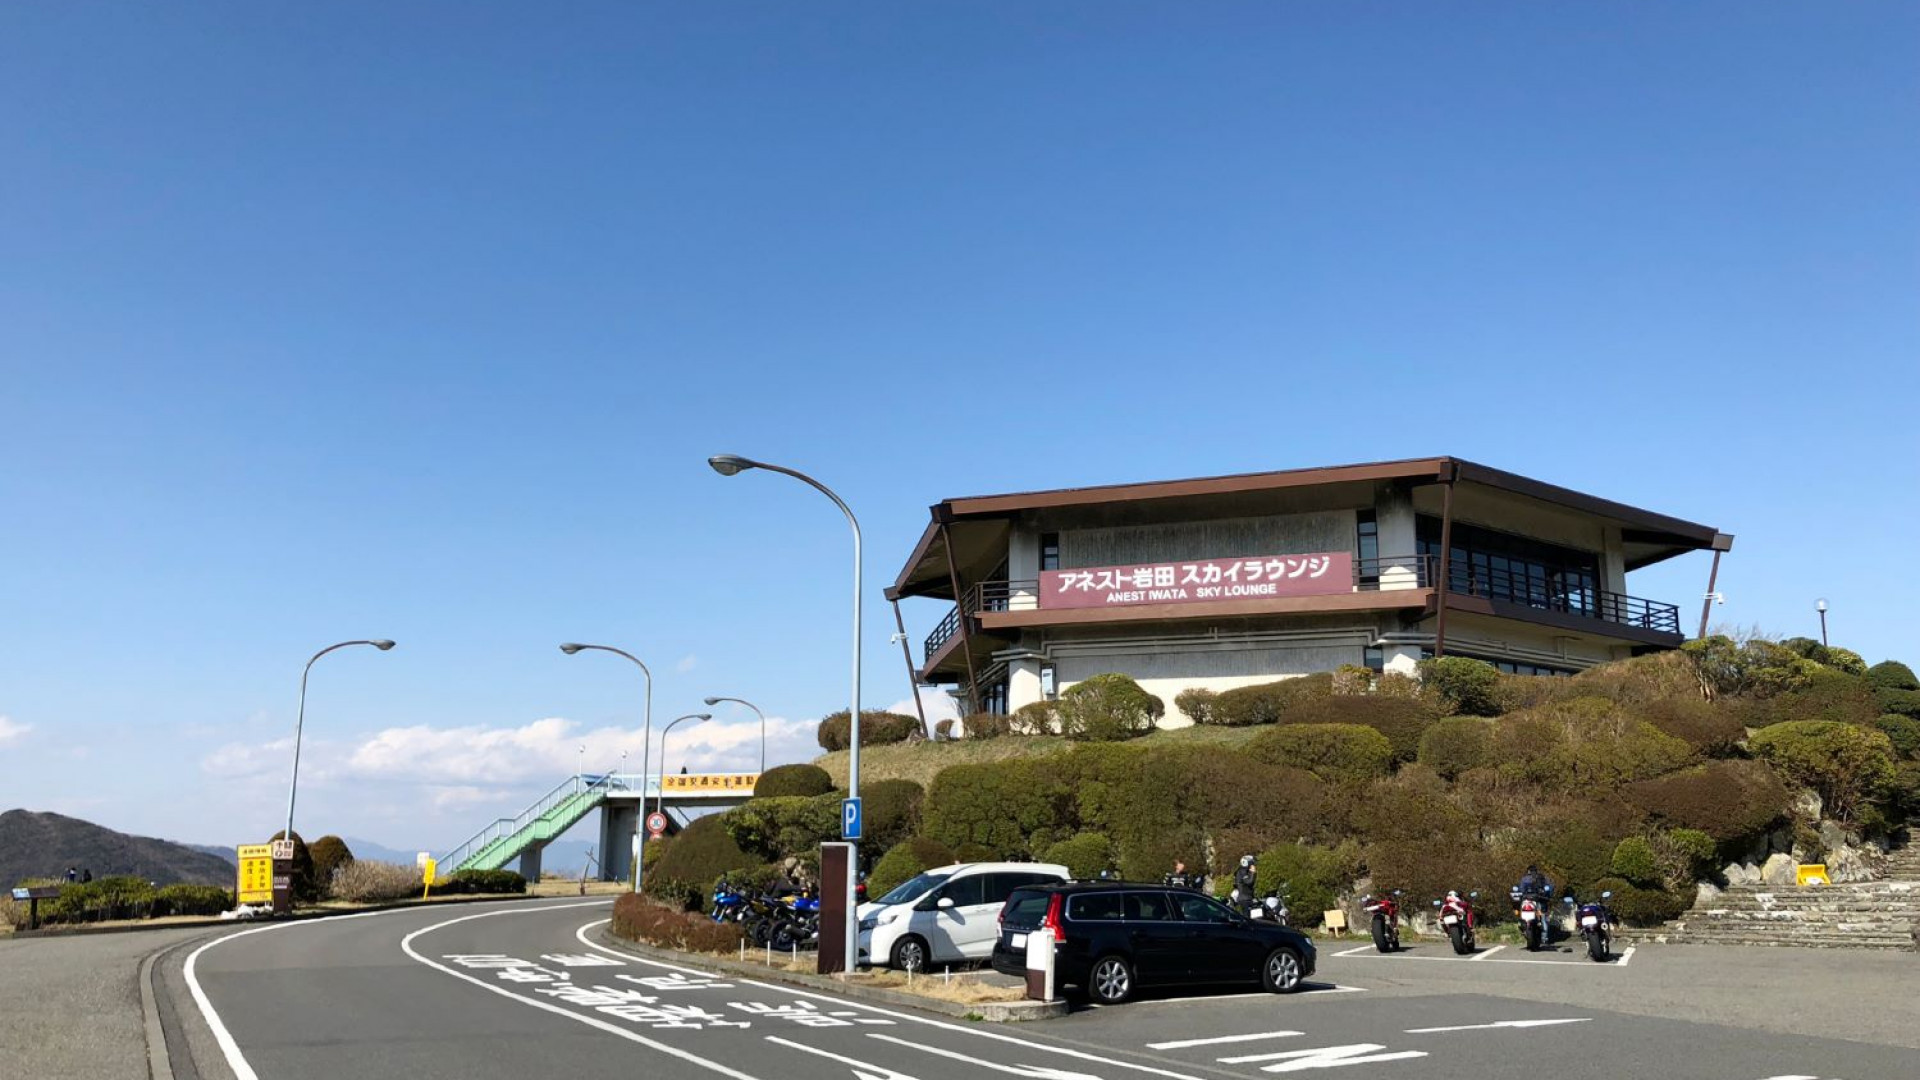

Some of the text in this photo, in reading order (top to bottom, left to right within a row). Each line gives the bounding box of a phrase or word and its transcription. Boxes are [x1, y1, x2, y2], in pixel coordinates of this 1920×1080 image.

[1058, 557, 1330, 593] アネスト岩田 スカイラウンジ
[1106, 583, 1277, 603] ANEST IWATA SKY LOUNGE
[846, 803, 856, 834] P
